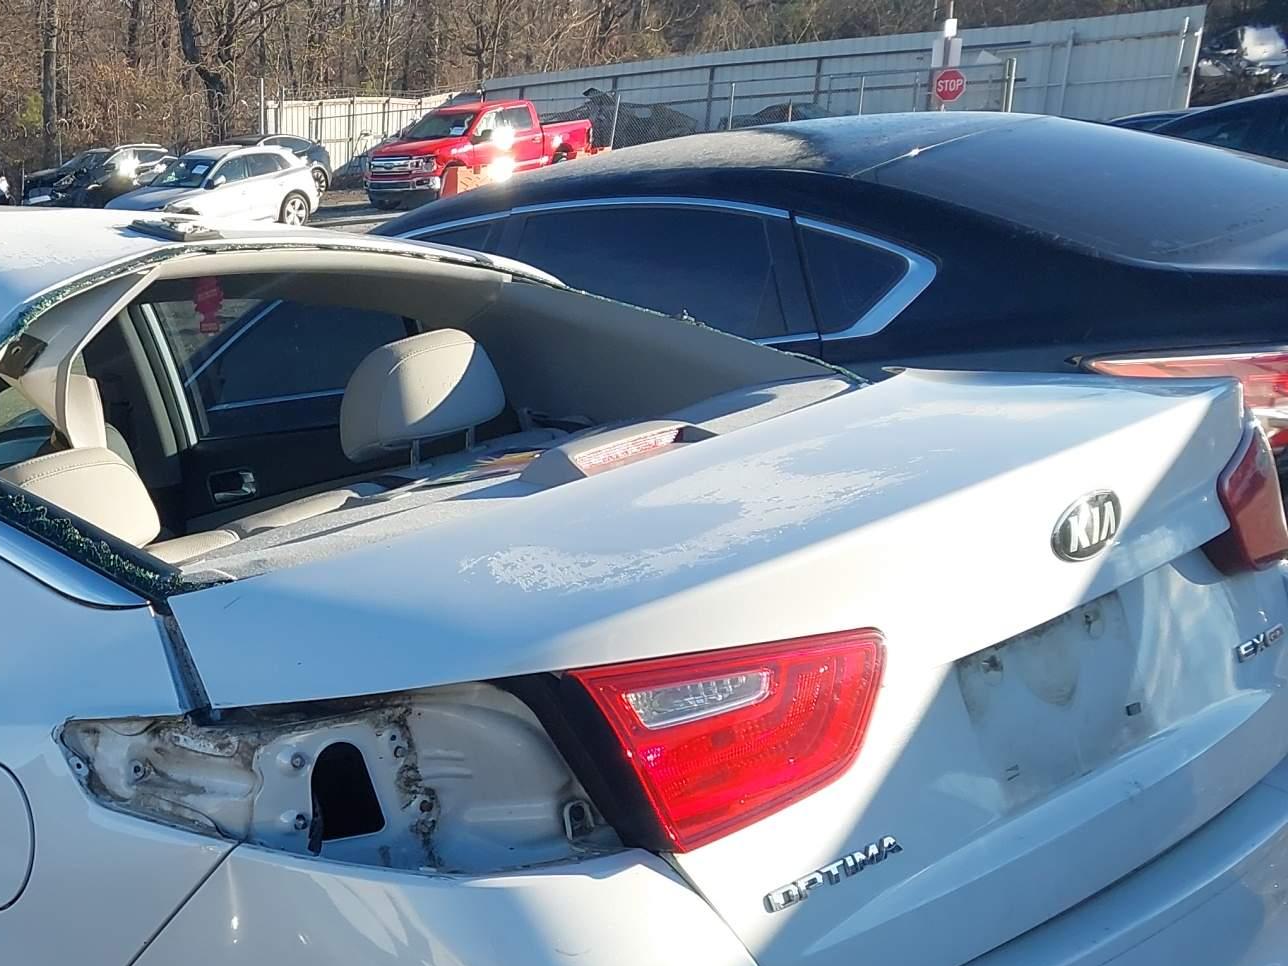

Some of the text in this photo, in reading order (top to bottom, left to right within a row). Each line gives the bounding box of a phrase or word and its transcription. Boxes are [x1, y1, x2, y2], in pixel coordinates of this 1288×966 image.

[936, 79, 963, 92] STOP
[1067, 500, 1116, 553] KIA
[763, 835, 903, 913] OPTIMA
